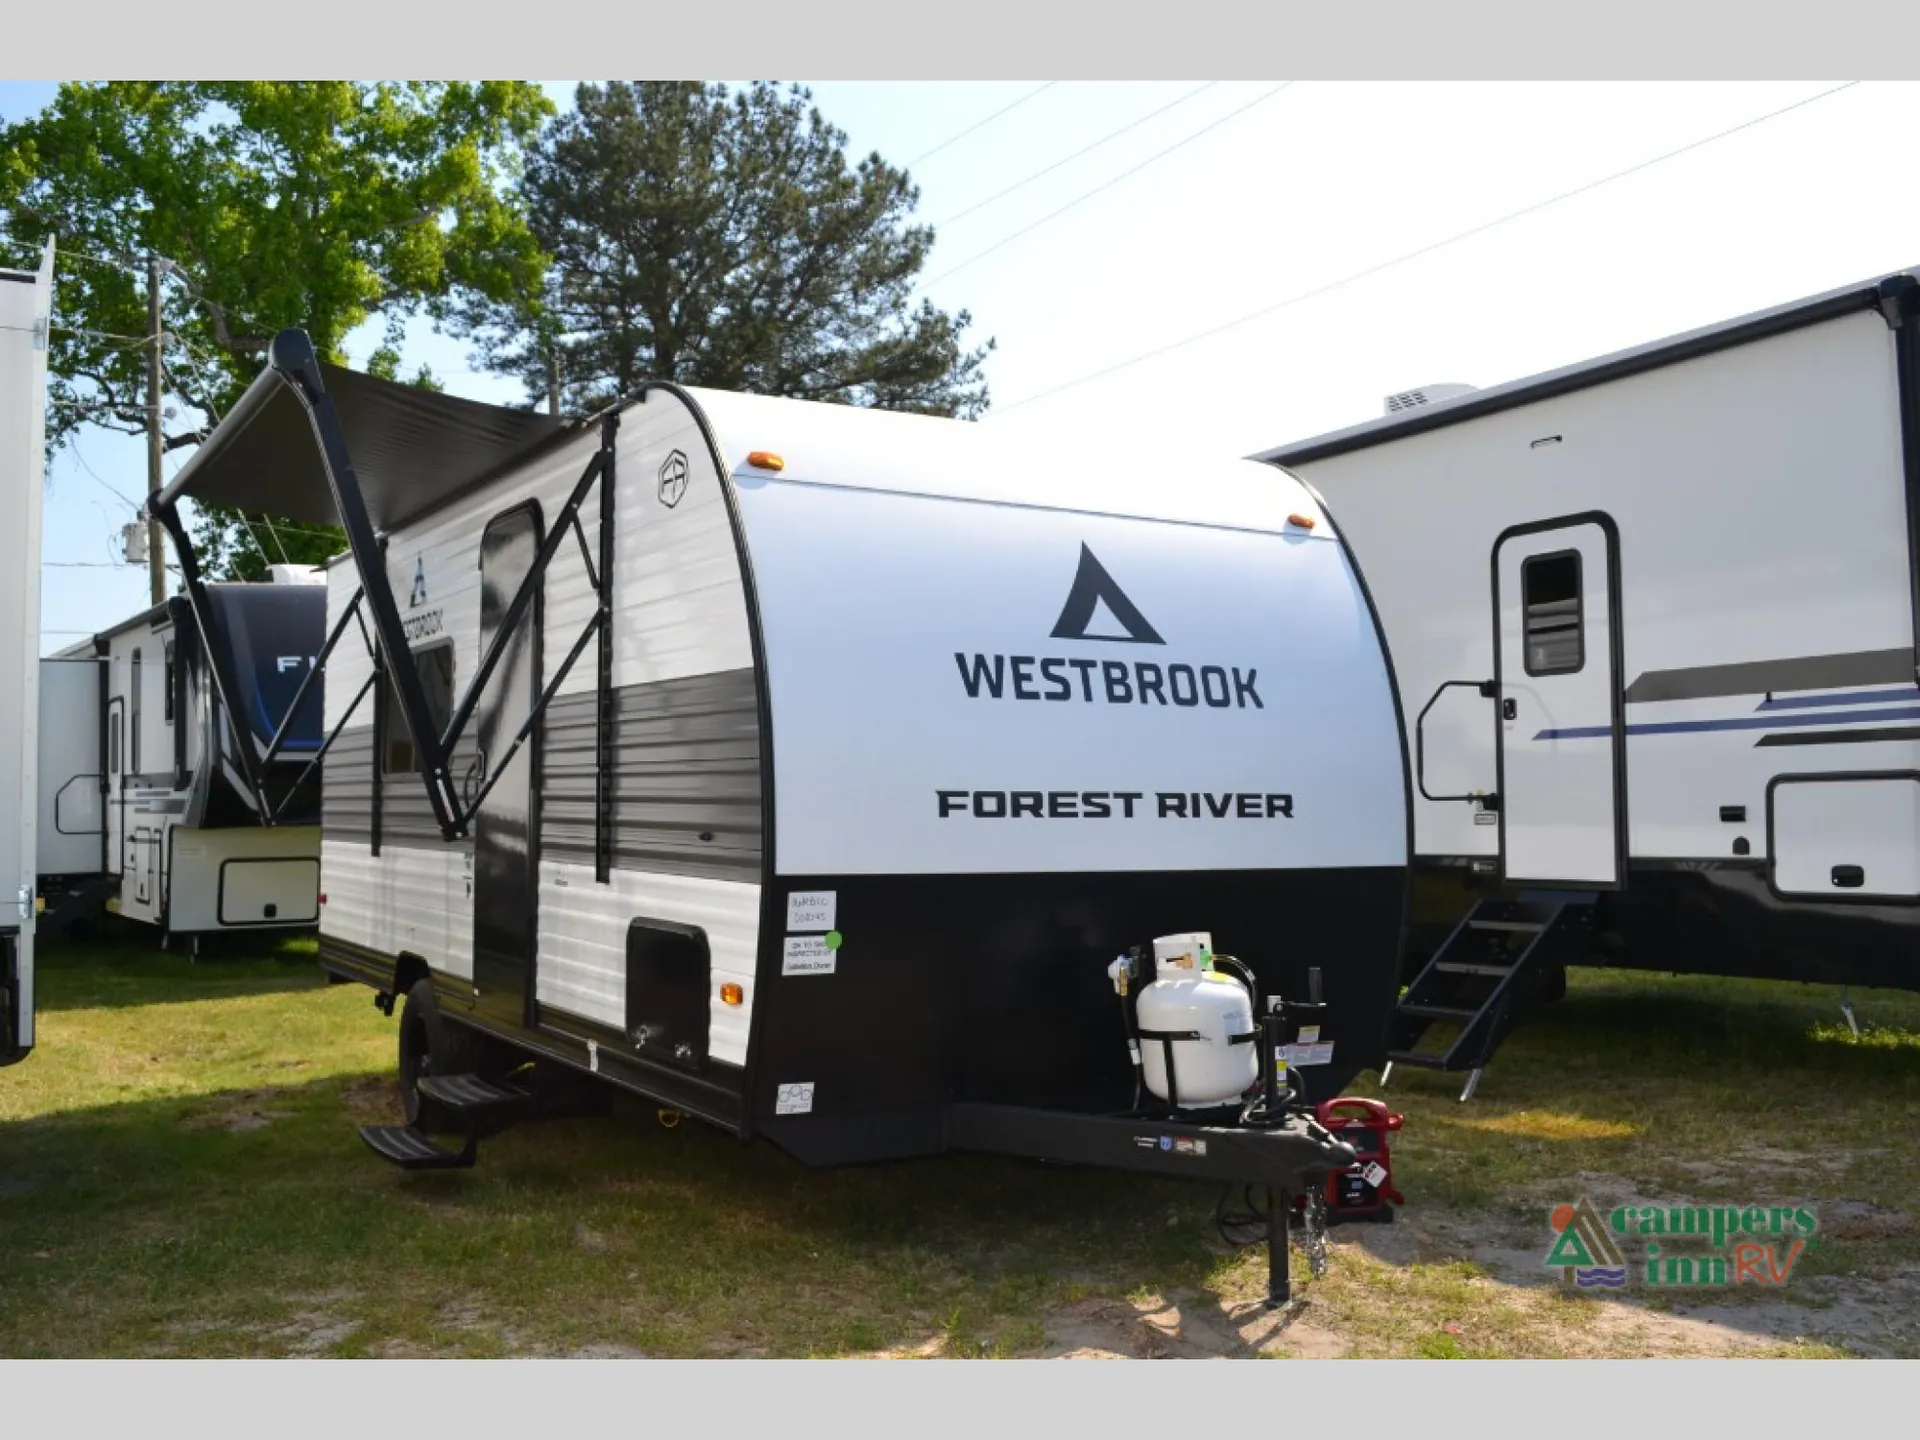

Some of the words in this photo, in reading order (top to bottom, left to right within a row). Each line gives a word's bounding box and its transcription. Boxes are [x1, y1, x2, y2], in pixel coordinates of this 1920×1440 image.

[954, 652, 1264, 709] WESTBROOK
[935, 790, 1143, 818] FOREST
[1155, 792, 1294, 818] RIVER
